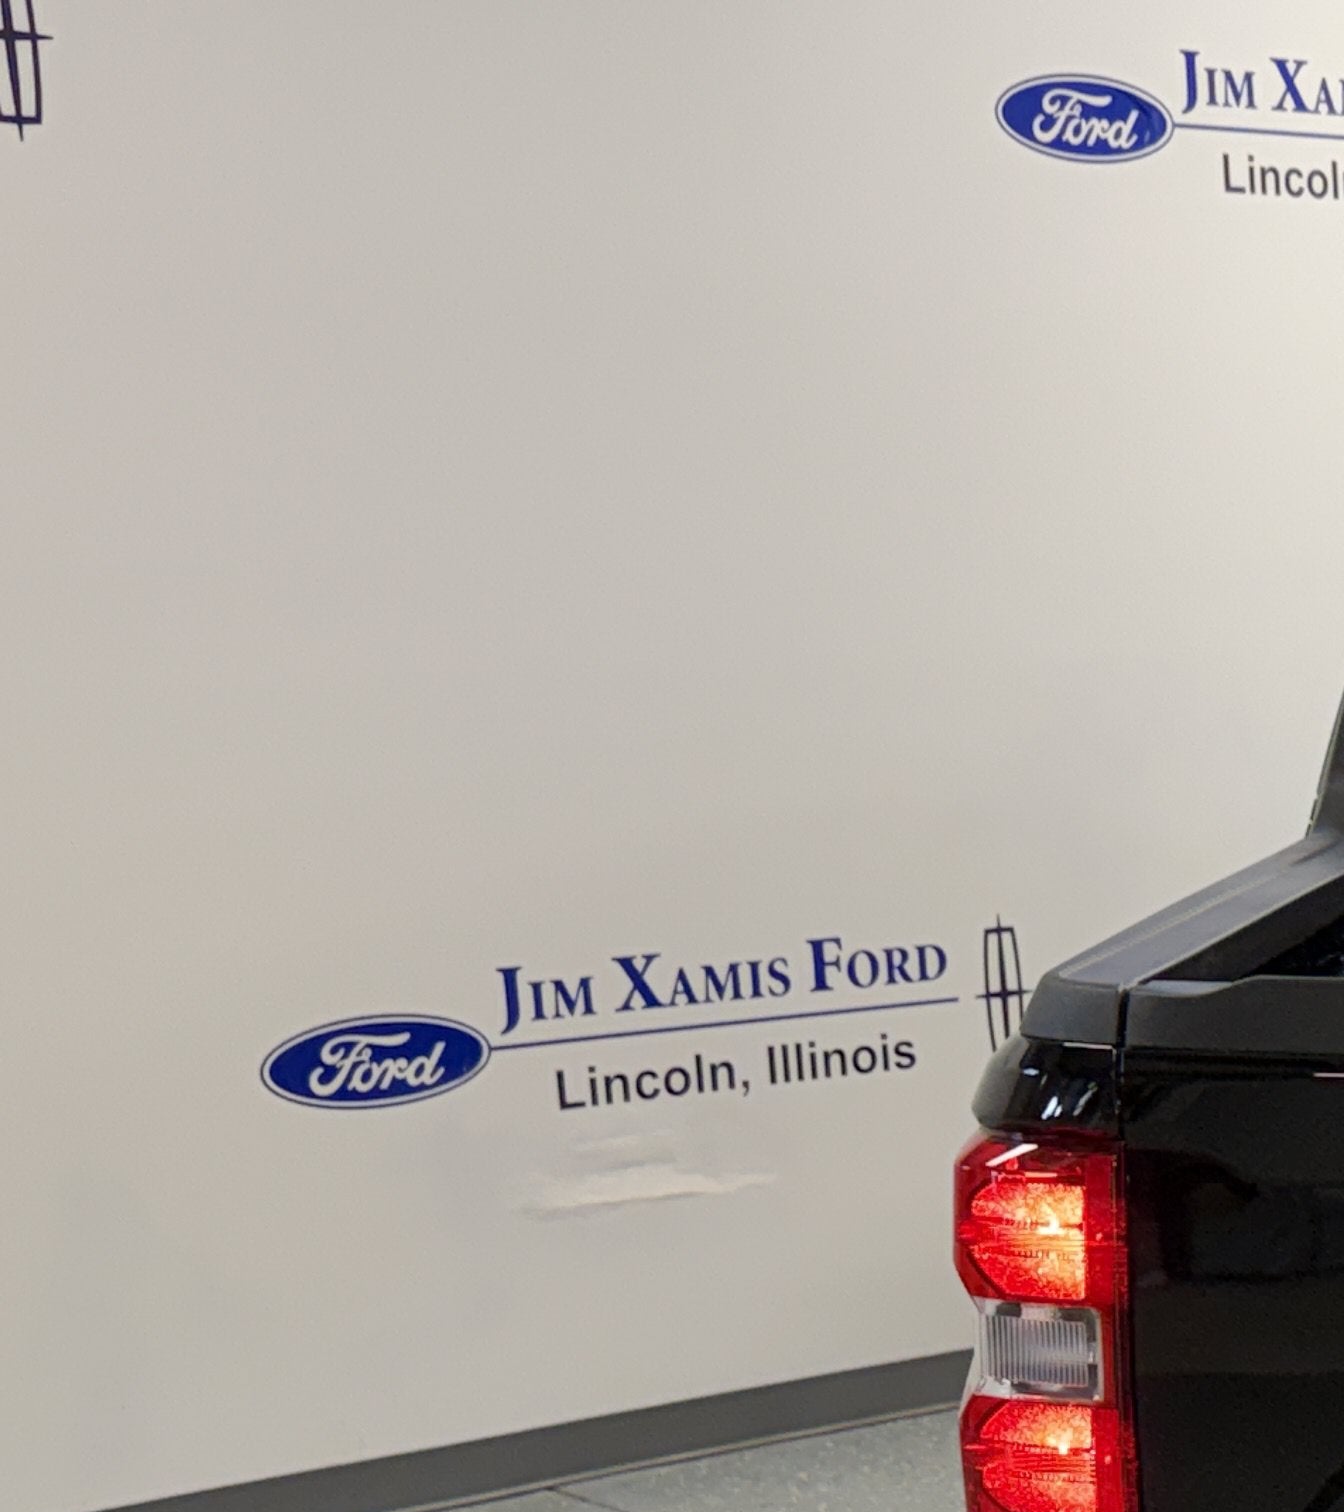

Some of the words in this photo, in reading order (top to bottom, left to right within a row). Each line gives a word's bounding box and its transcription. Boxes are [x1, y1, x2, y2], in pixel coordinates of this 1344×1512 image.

[1180, 50, 1256, 114] JIM
[1032, 86, 1139, 150] Ford
[496, 967, 596, 1035] JIM
[612, 953, 792, 1012] XAMIS
[806, 937, 947, 992] FORD
[309, 1032, 445, 1097] Ford
[555, 1053, 751, 1111] Lincoln,
[767, 1034, 917, 1087] Illinois
